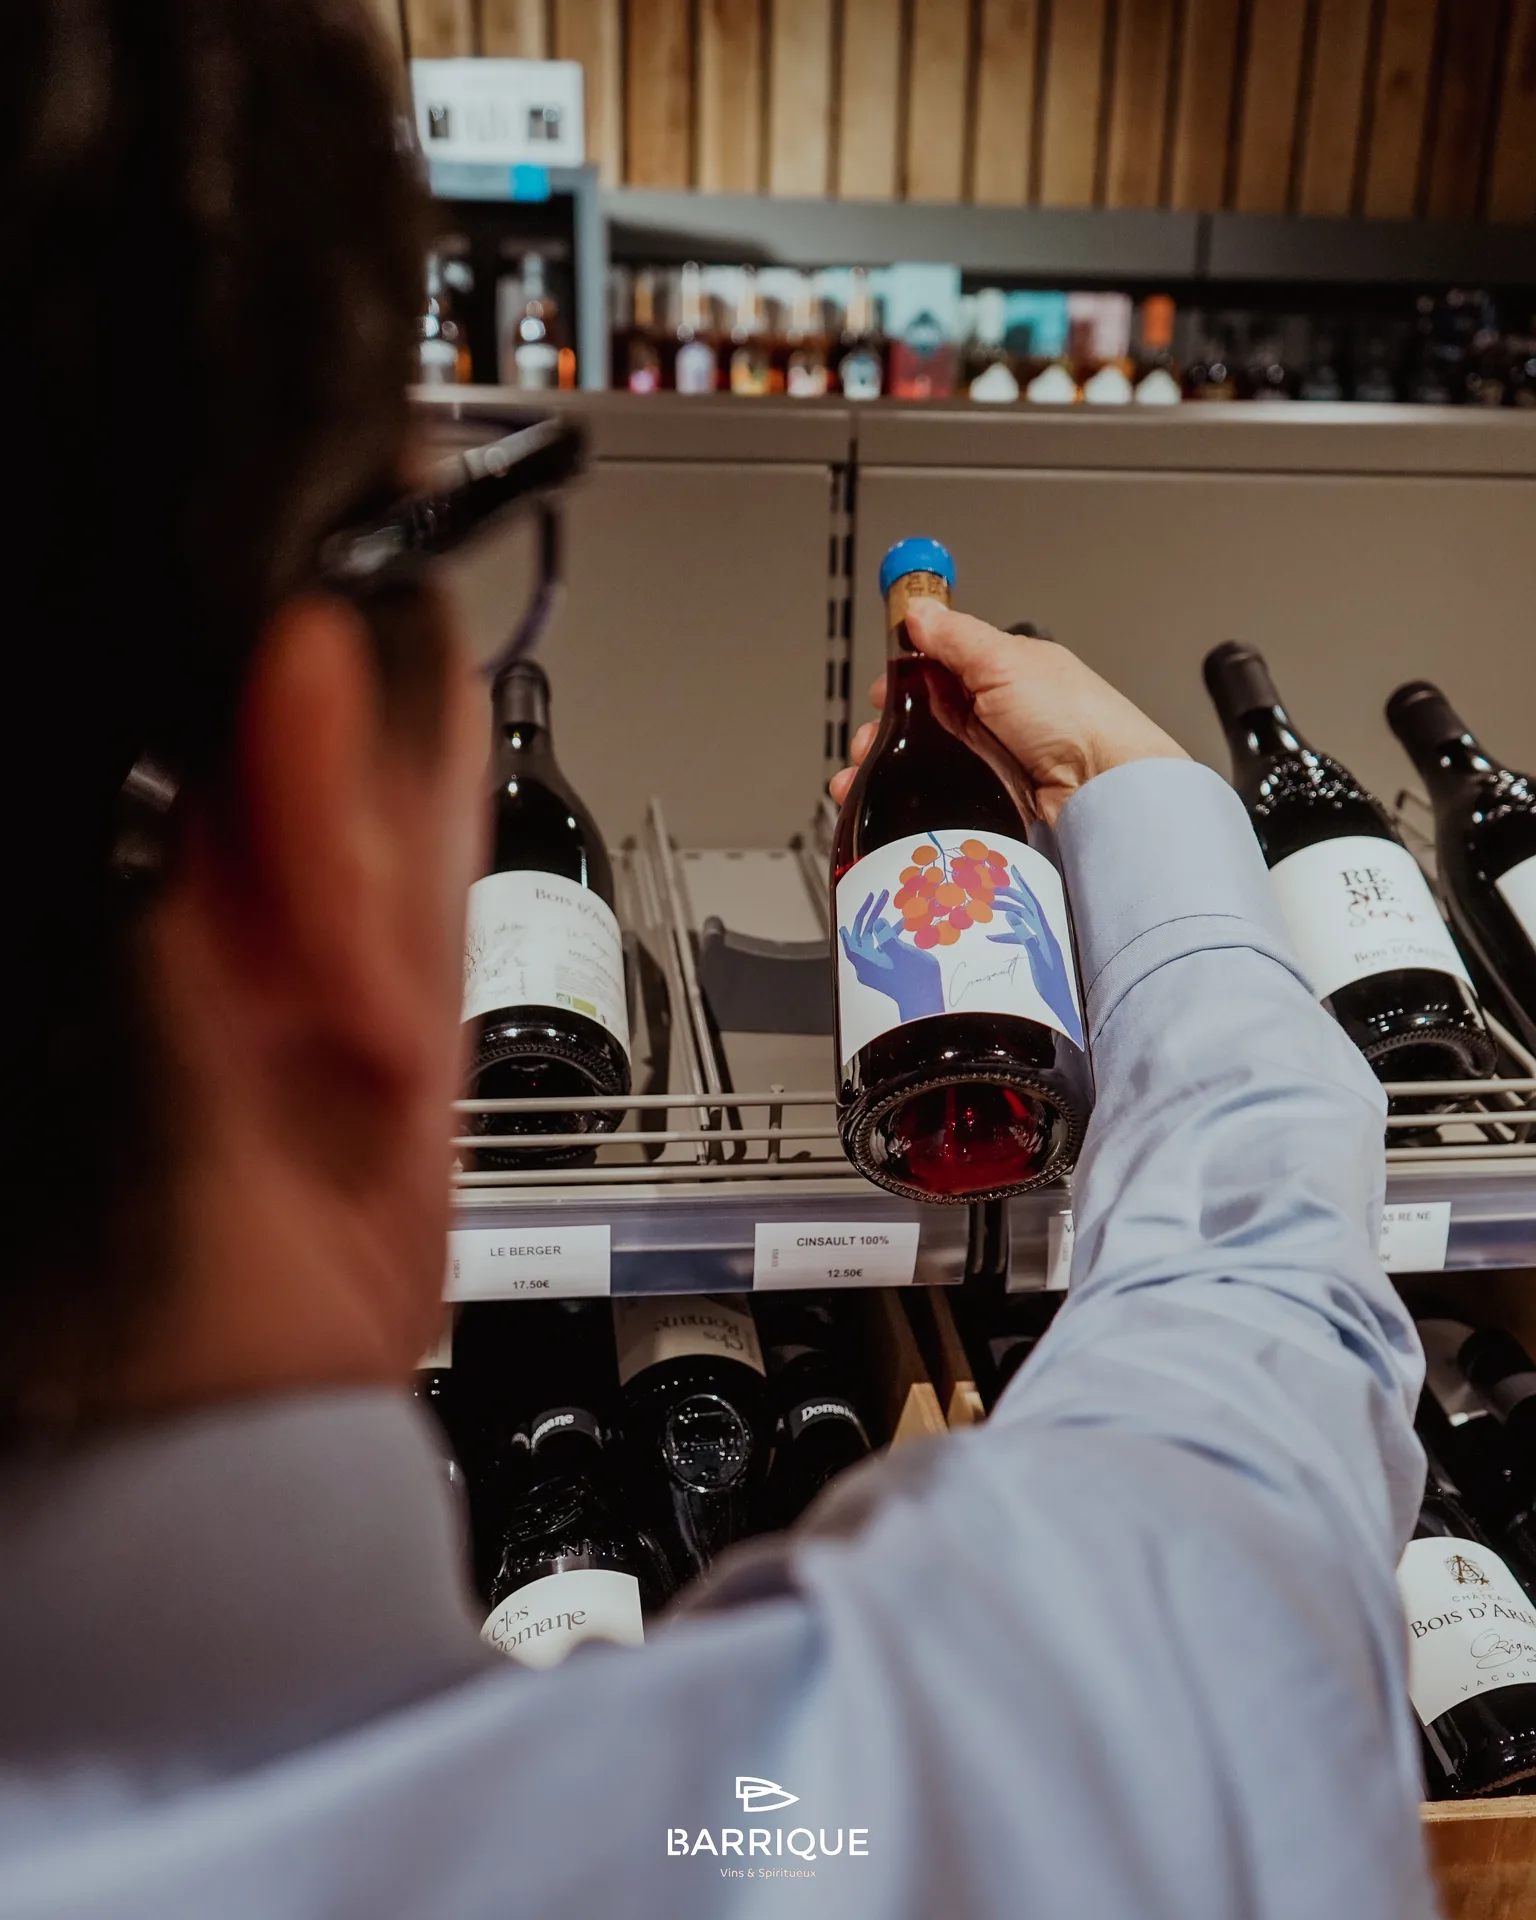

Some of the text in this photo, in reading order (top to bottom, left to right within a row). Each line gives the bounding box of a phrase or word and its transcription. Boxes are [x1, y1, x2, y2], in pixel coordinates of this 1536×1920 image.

[796, 1235, 890, 1247] CINSAULT 100%
[490, 1245, 562, 1257] LE BERGER
[827, 1268, 864, 1278] 12.50€
[512, 1279, 550, 1290] 17.50€
[492, 1605, 530, 1641] Clos
[1409, 1610, 1463, 1639] BOIS
